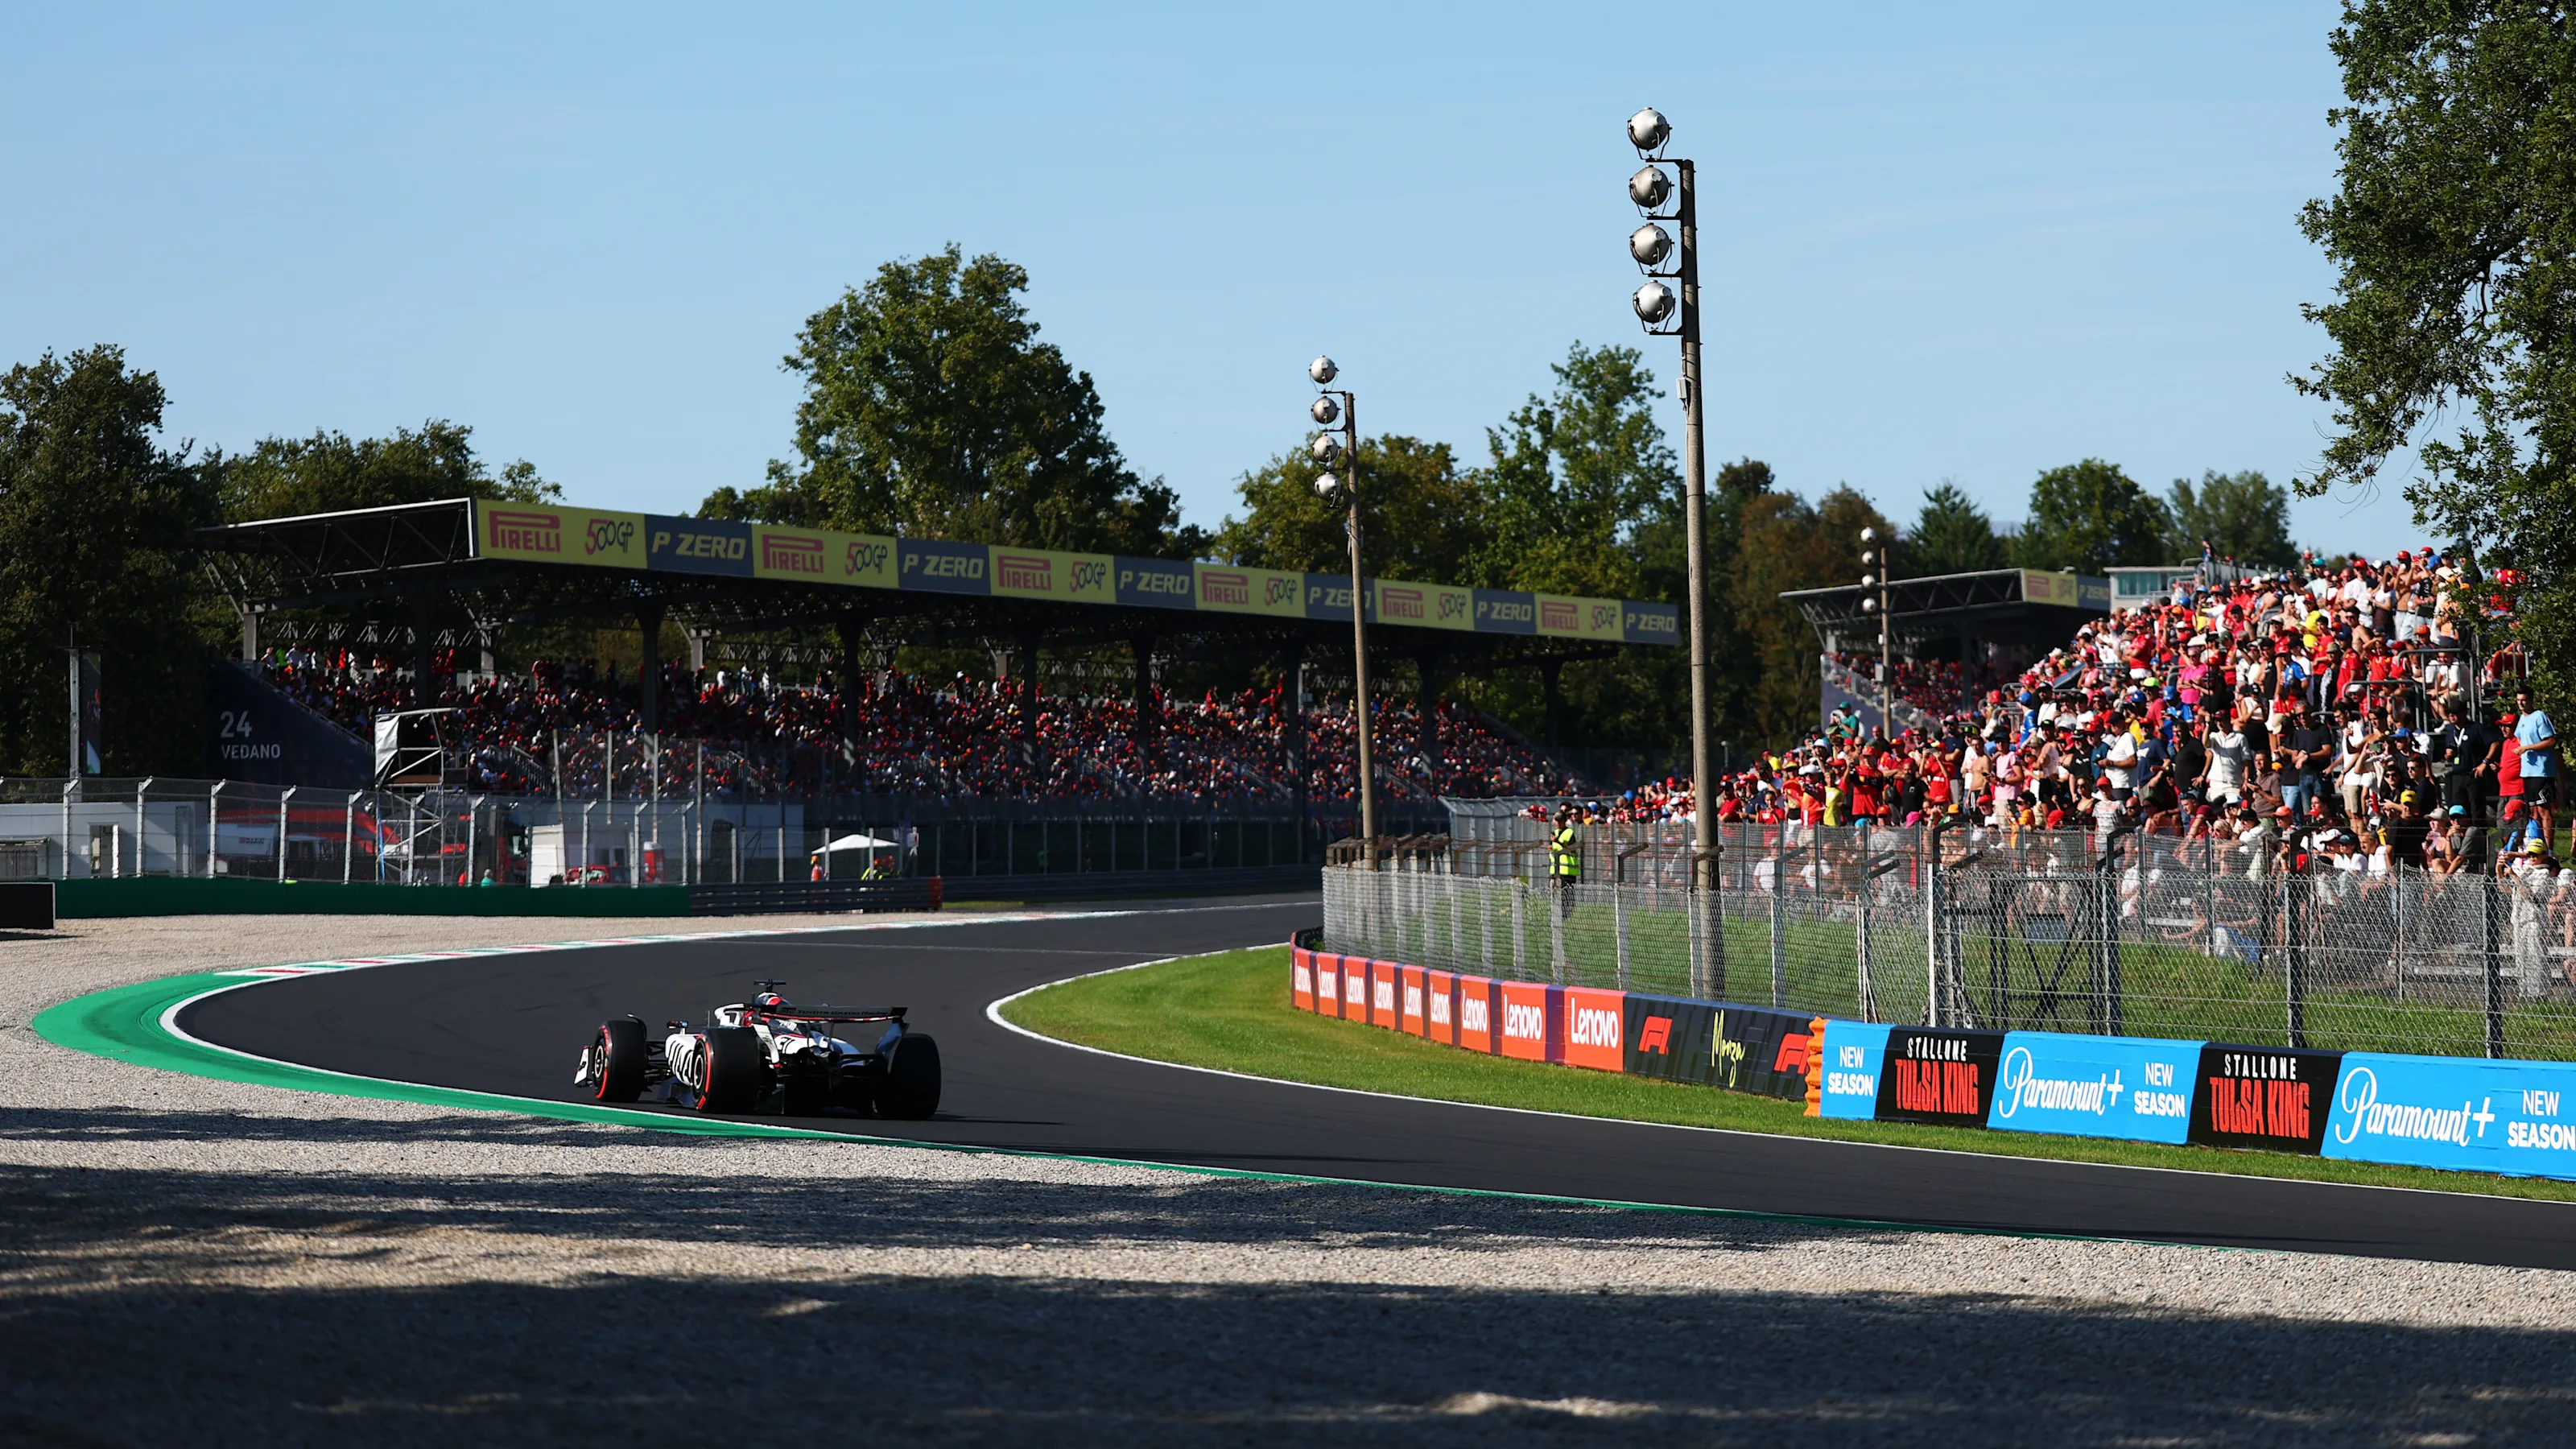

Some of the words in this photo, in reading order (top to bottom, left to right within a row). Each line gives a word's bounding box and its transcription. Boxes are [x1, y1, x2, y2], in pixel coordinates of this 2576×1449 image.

[489, 510, 561, 552] PIRELLI
[652, 531, 671, 553] P
[675, 533, 746, 560] ZERO
[762, 534, 824, 573] PIRELLI
[902, 553, 919, 573] P
[923, 555, 984, 579] ZERO
[997, 555, 1051, 591] PIRELLI
[1120, 570, 1133, 589] P
[1137, 572, 1190, 594] ZERO
[1201, 571, 1249, 604] PIRELLI
[1309, 586, 1322, 605] P
[1381, 587, 1424, 619] PIRELLI
[1476, 601, 1488, 619] P
[1491, 602, 1533, 621] ZERO
[1541, 601, 1579, 630] PIRELLI
[1626, 613, 1636, 629] P
[1638, 613, 1676, 633] ZERO
[220, 710, 253, 739] 24
[221, 742, 281, 761] VEDANO
[1318, 963, 1336, 1000] Lenovo
[1345, 968, 1364, 1005] Lenovo
[1373, 972, 1393, 1011] Lenovo
[1404, 977, 1422, 1018] Lenovo
[1430, 983, 1450, 1025] Lenovo
[1462, 989, 1488, 1033] Lenovo
[1504, 993, 1542, 1040] Lenovo
[1571, 997, 1619, 1048] Lenovo
[1711, 1009, 1745, 1088] Monza
[1839, 1046, 1864, 1067] NEW
[1907, 1036, 1967, 1062] STALLONE
[2145, 1062, 2173, 1087] NEW
[2224, 1053, 2297, 1080] STALLONE
[1827, 1072, 1874, 1096] SEASON
[1895, 1059, 1941, 1112] TULSA
[1942, 1061, 1979, 1115] KING
[2133, 1092, 2186, 1117] SEASON
[2209, 1076, 2264, 1133] TULSA
[2265, 1080, 2310, 1139] KING
[2522, 1089, 2560, 1117] NEW
[2507, 1120, 2576, 1151] SEASON
